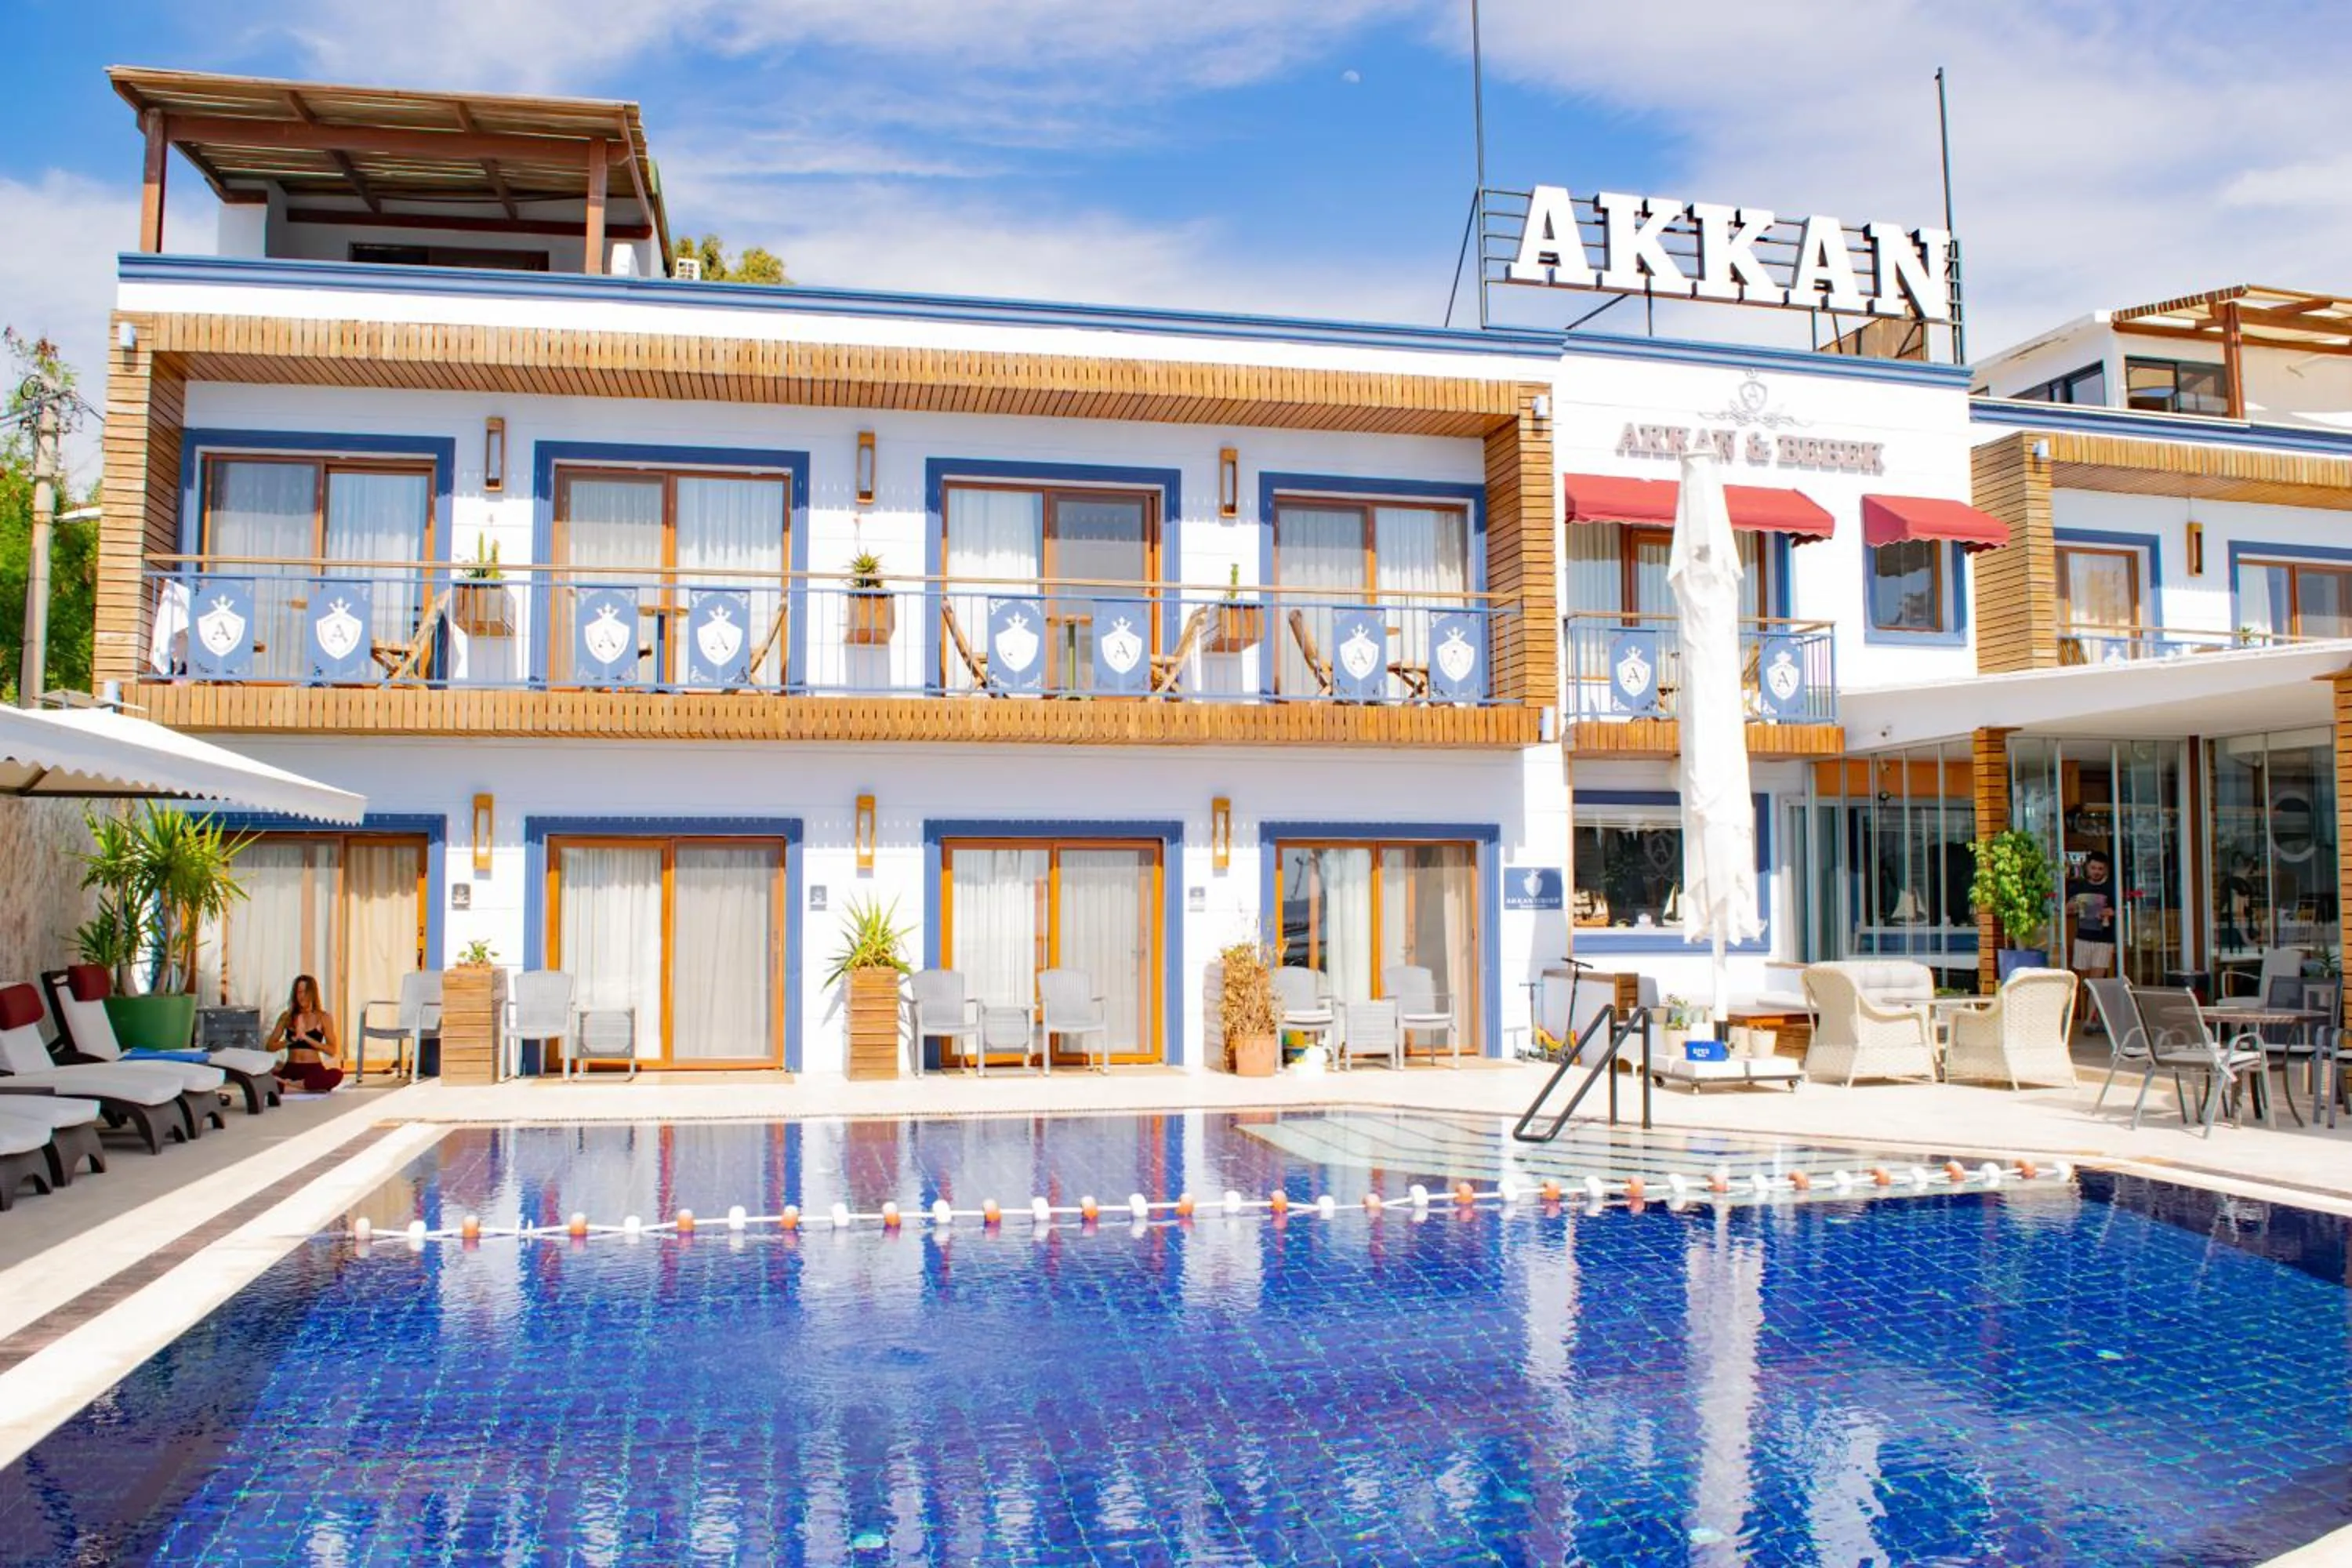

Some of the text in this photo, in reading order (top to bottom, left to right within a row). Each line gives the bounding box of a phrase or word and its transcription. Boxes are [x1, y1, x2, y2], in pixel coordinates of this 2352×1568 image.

[1505, 185, 1952, 321] AKKAN
[1616, 422, 1885, 476] AKKAN & BEBEK
[211, 620, 231, 641] A
[328, 623, 348, 644] A
[1626, 666, 1641, 684] A
[1776, 670, 1790, 688] A
